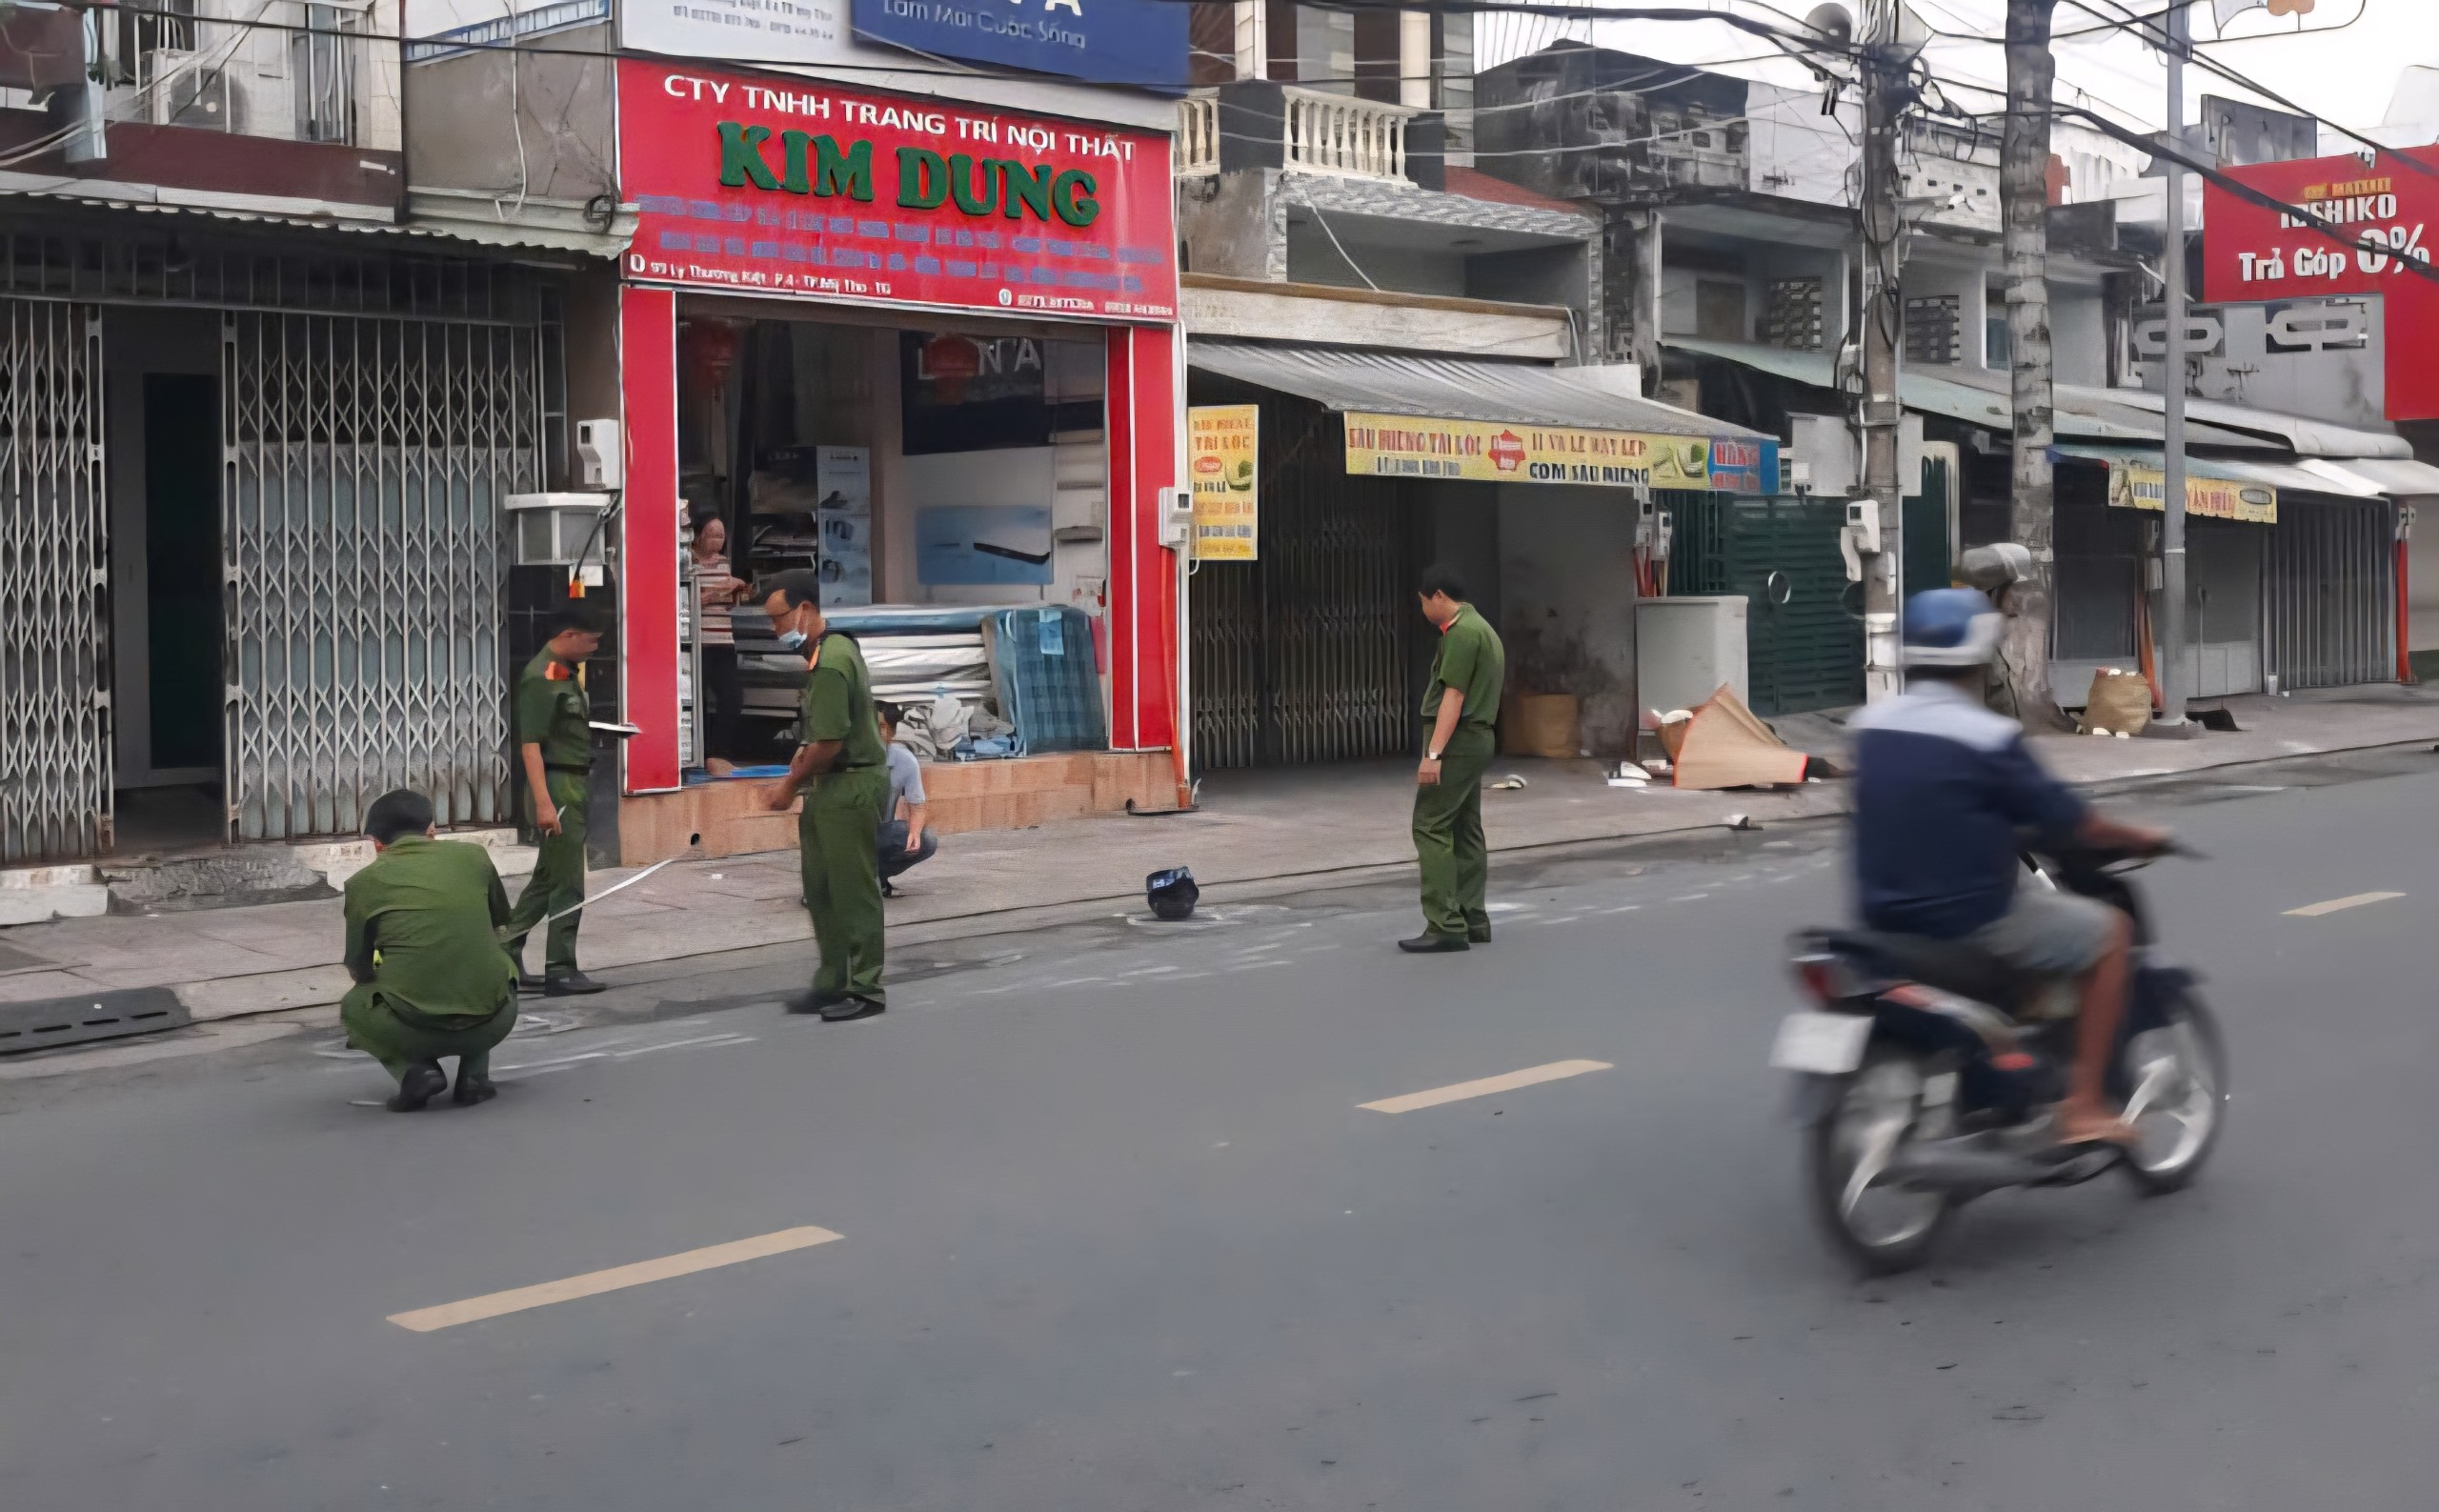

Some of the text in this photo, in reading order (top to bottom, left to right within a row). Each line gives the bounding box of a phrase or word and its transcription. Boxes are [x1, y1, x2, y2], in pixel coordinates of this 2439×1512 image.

[664, 75, 730, 104] CTY
[741, 86, 830, 119] TNHH
[839, 100, 946, 135] TRANG
[955, 117, 998, 143] TRÍ
[717, 121, 874, 202] KIM
[896, 147, 1100, 227] DUNG
[2294, 246, 2347, 280] Góp
